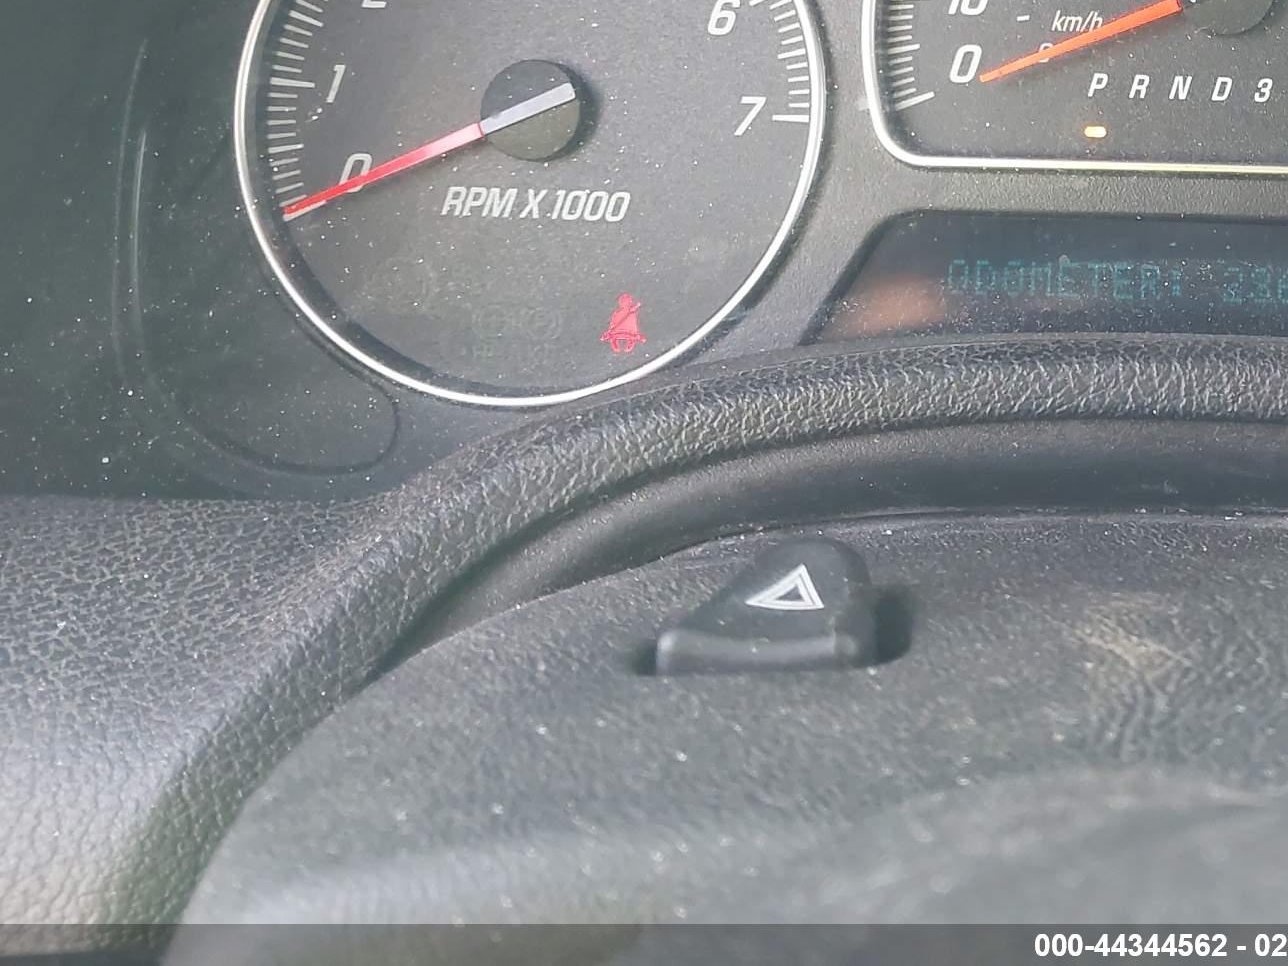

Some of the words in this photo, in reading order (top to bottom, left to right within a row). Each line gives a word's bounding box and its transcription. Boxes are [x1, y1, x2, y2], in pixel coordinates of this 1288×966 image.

[1051, 9, 1103, 33] km/h
[949, 44, 983, 83] 0
[326, 64, 347, 103] 1
[1087, 72, 1109, 97] P
[1128, 74, 1150, 99] R
[1168, 75, 1193, 100] N
[1211, 76, 1233, 101] D
[1254, 78, 1273, 103] 3
[733, 96, 767, 136] 7
[338, 153, 371, 193] 0
[440, 186, 516, 217] RPM
[519, 188, 543, 219] X
[551, 189, 631, 222] 1000
